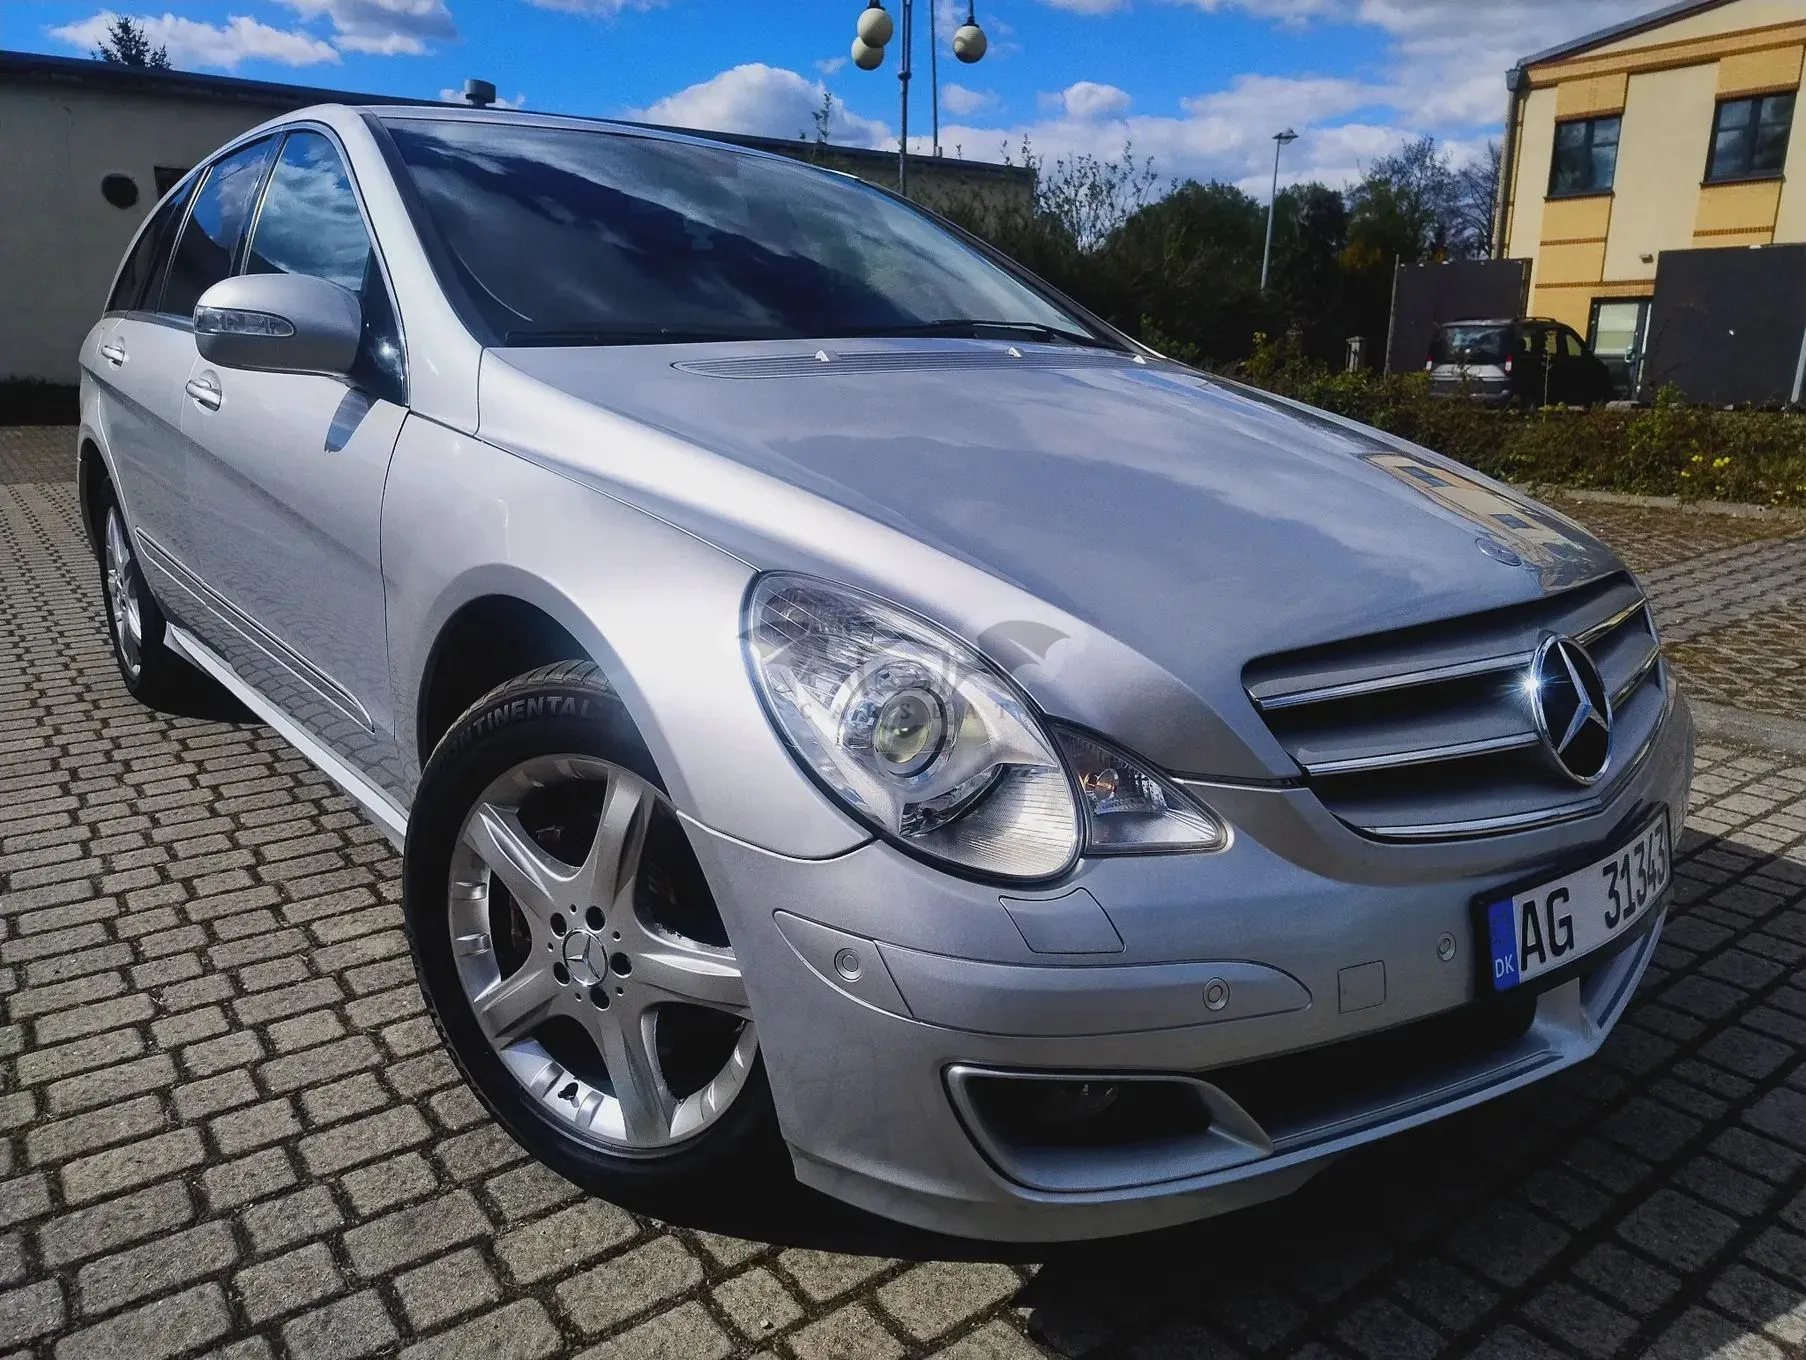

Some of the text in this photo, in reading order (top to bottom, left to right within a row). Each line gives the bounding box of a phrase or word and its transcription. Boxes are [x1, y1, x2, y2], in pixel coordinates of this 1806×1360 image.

[1520, 822, 1666, 972] AG 31343
[1495, 954, 1514, 978] DK
